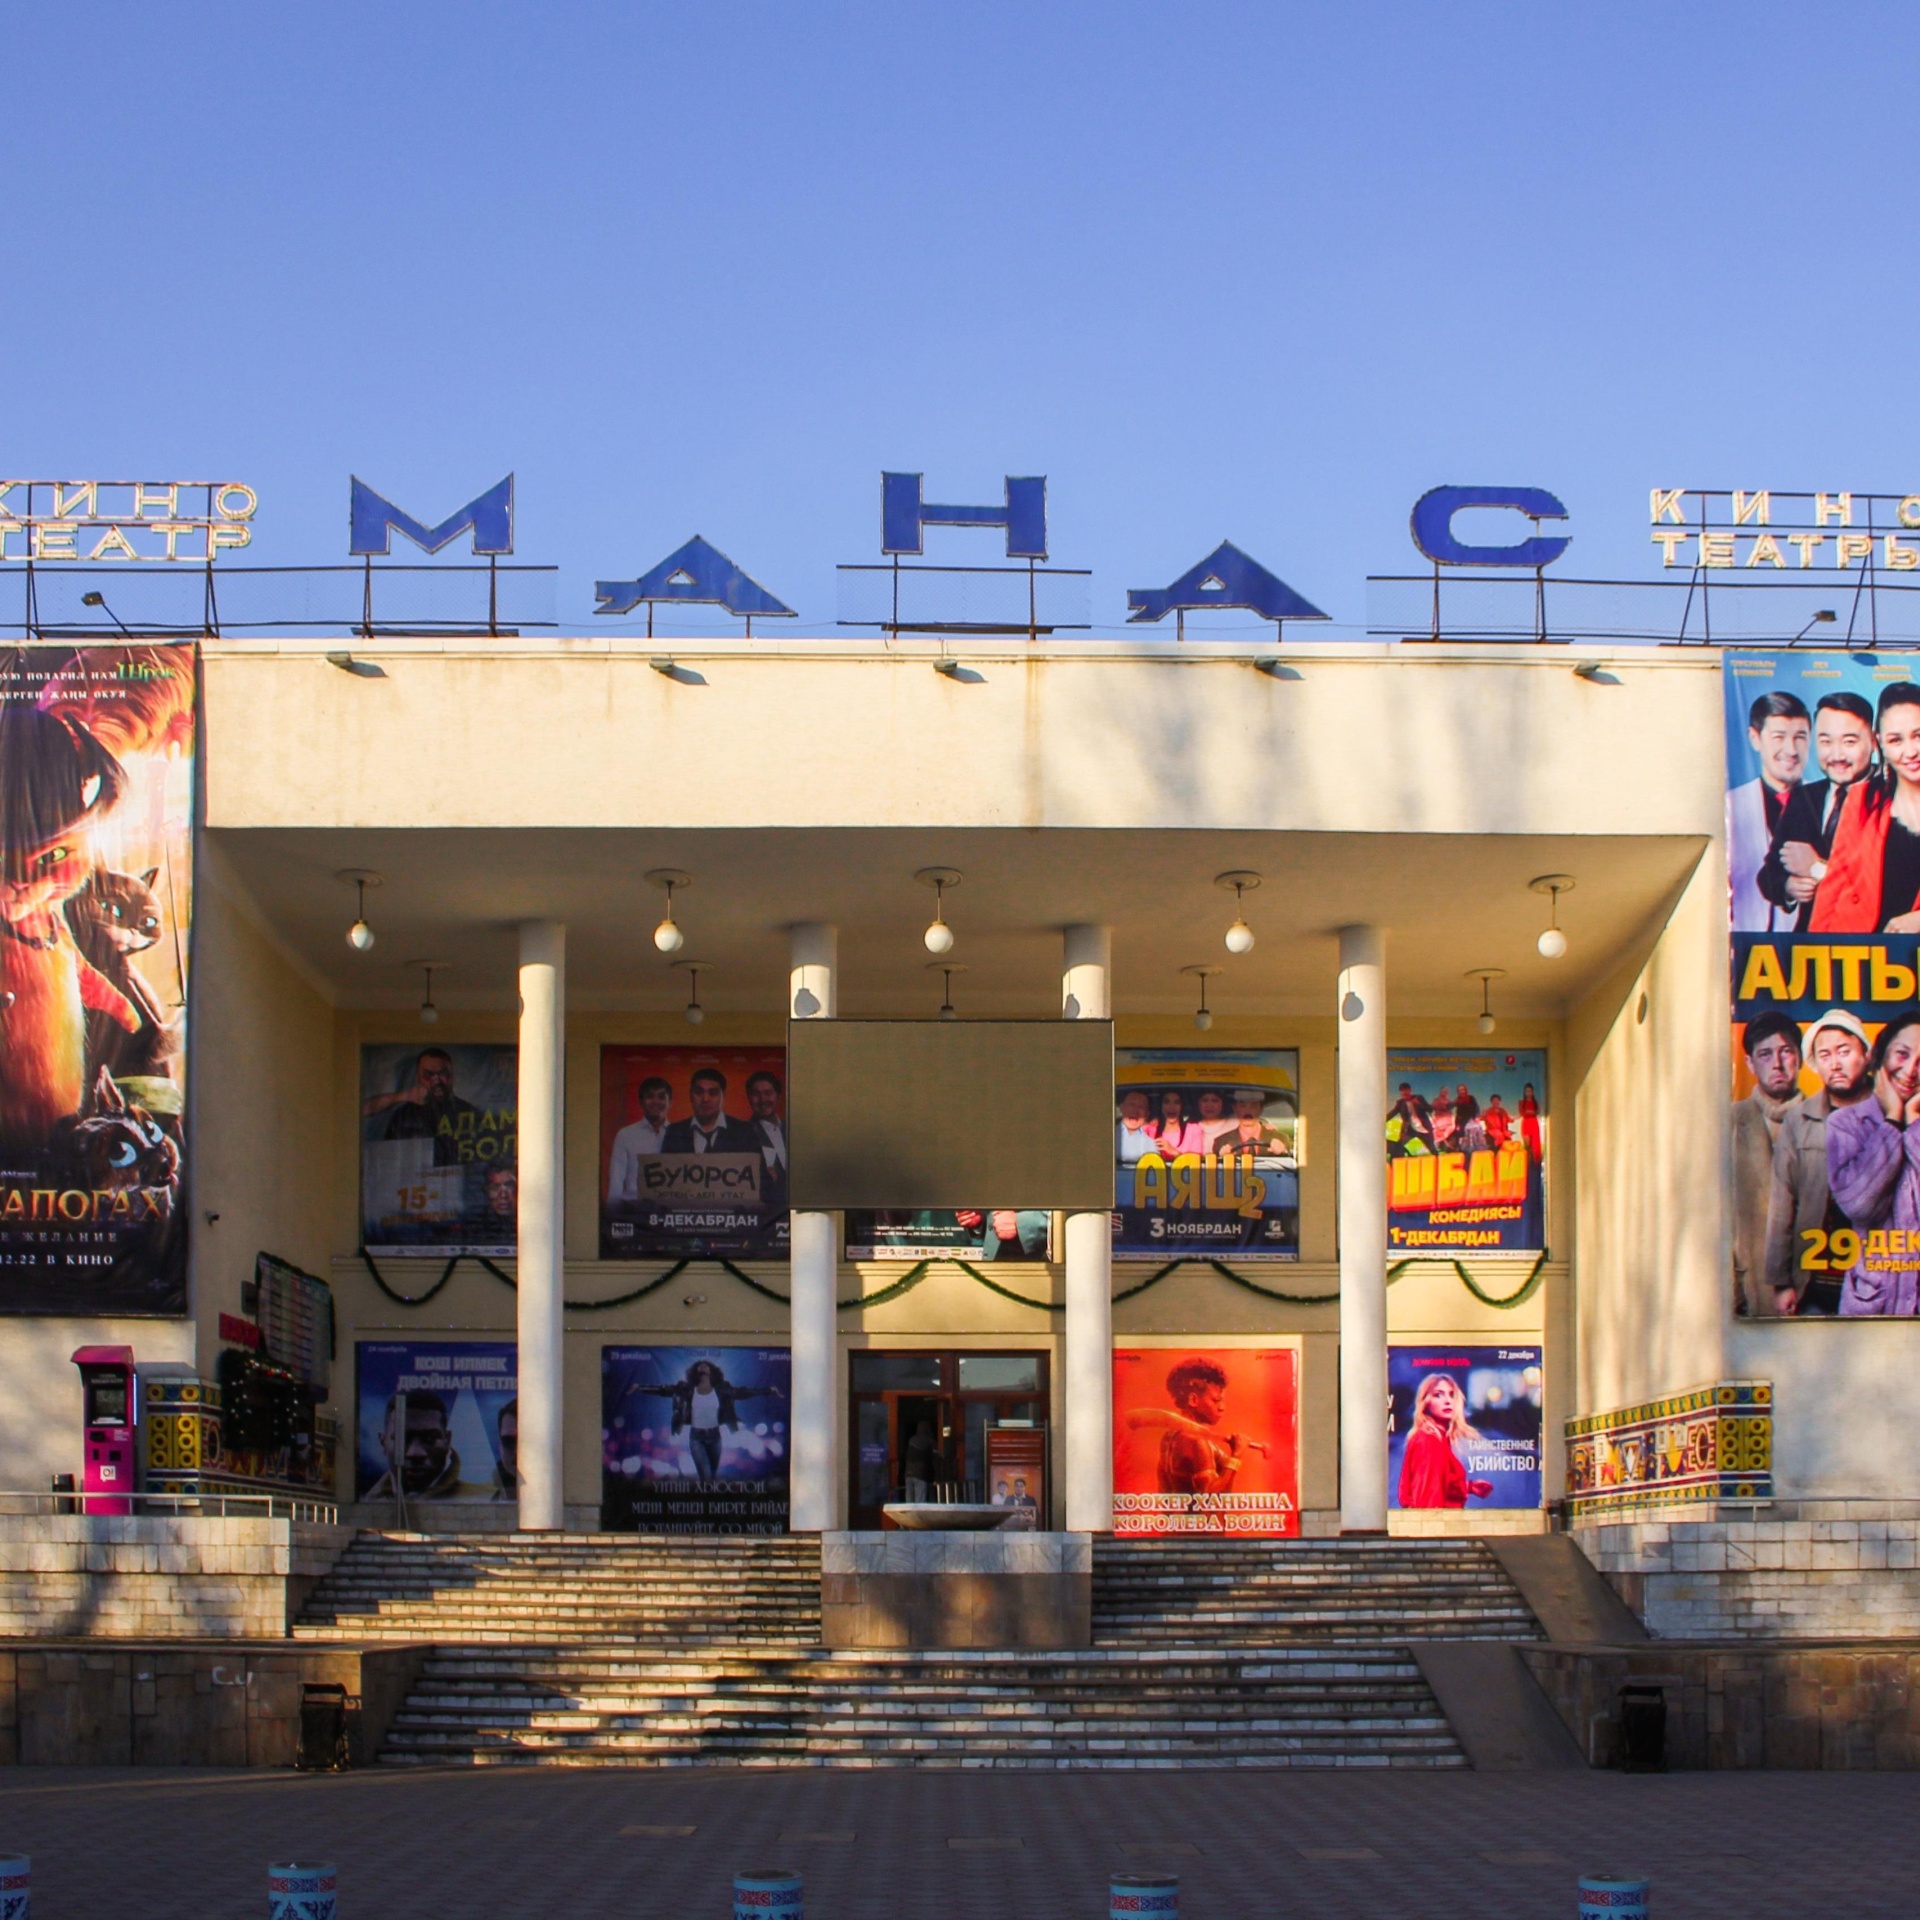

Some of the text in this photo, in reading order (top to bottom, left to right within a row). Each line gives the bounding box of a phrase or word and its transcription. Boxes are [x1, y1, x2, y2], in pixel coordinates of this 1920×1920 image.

[1651, 488, 1920, 529] КИНО
[350, 471, 1573, 620] МАНАС
[27, 671, 85, 681] ПОДАРИЛ
[91, 671, 117, 680] НАМ
[93, 690, 126, 699] ОКУЯ
[644, 1162, 756, 1191] БУЮРСА
[1386, 1140, 1529, 1213] ШБАЙ
[0, 1187, 166, 1221] АПОГАХ
[649, 1214, 758, 1228] 8-ДЕКАБРДАН
[1429, 1206, 1522, 1224] КОМЕДИЯСЫ
[22, 1232, 118, 1242] ЖЕЛАНИЕ
[1150, 1218, 1242, 1238] 3 НОЯБРДАН
[1389, 1226, 1501, 1246] 1-ДЕКАБРДАН
[47, 1254, 55, 1264] В
[66, 1254, 114, 1265] КИНО
[397, 1372, 517, 1391] ДВОЙНАЯ ПЕТЛ
[1468, 1439, 1535, 1451] ТАИНСТВЕННОЕ
[1468, 1453, 1535, 1473] УБИЙСТВО
[1113, 1514, 1287, 1531] КОРОЛЕВА ВОИН
